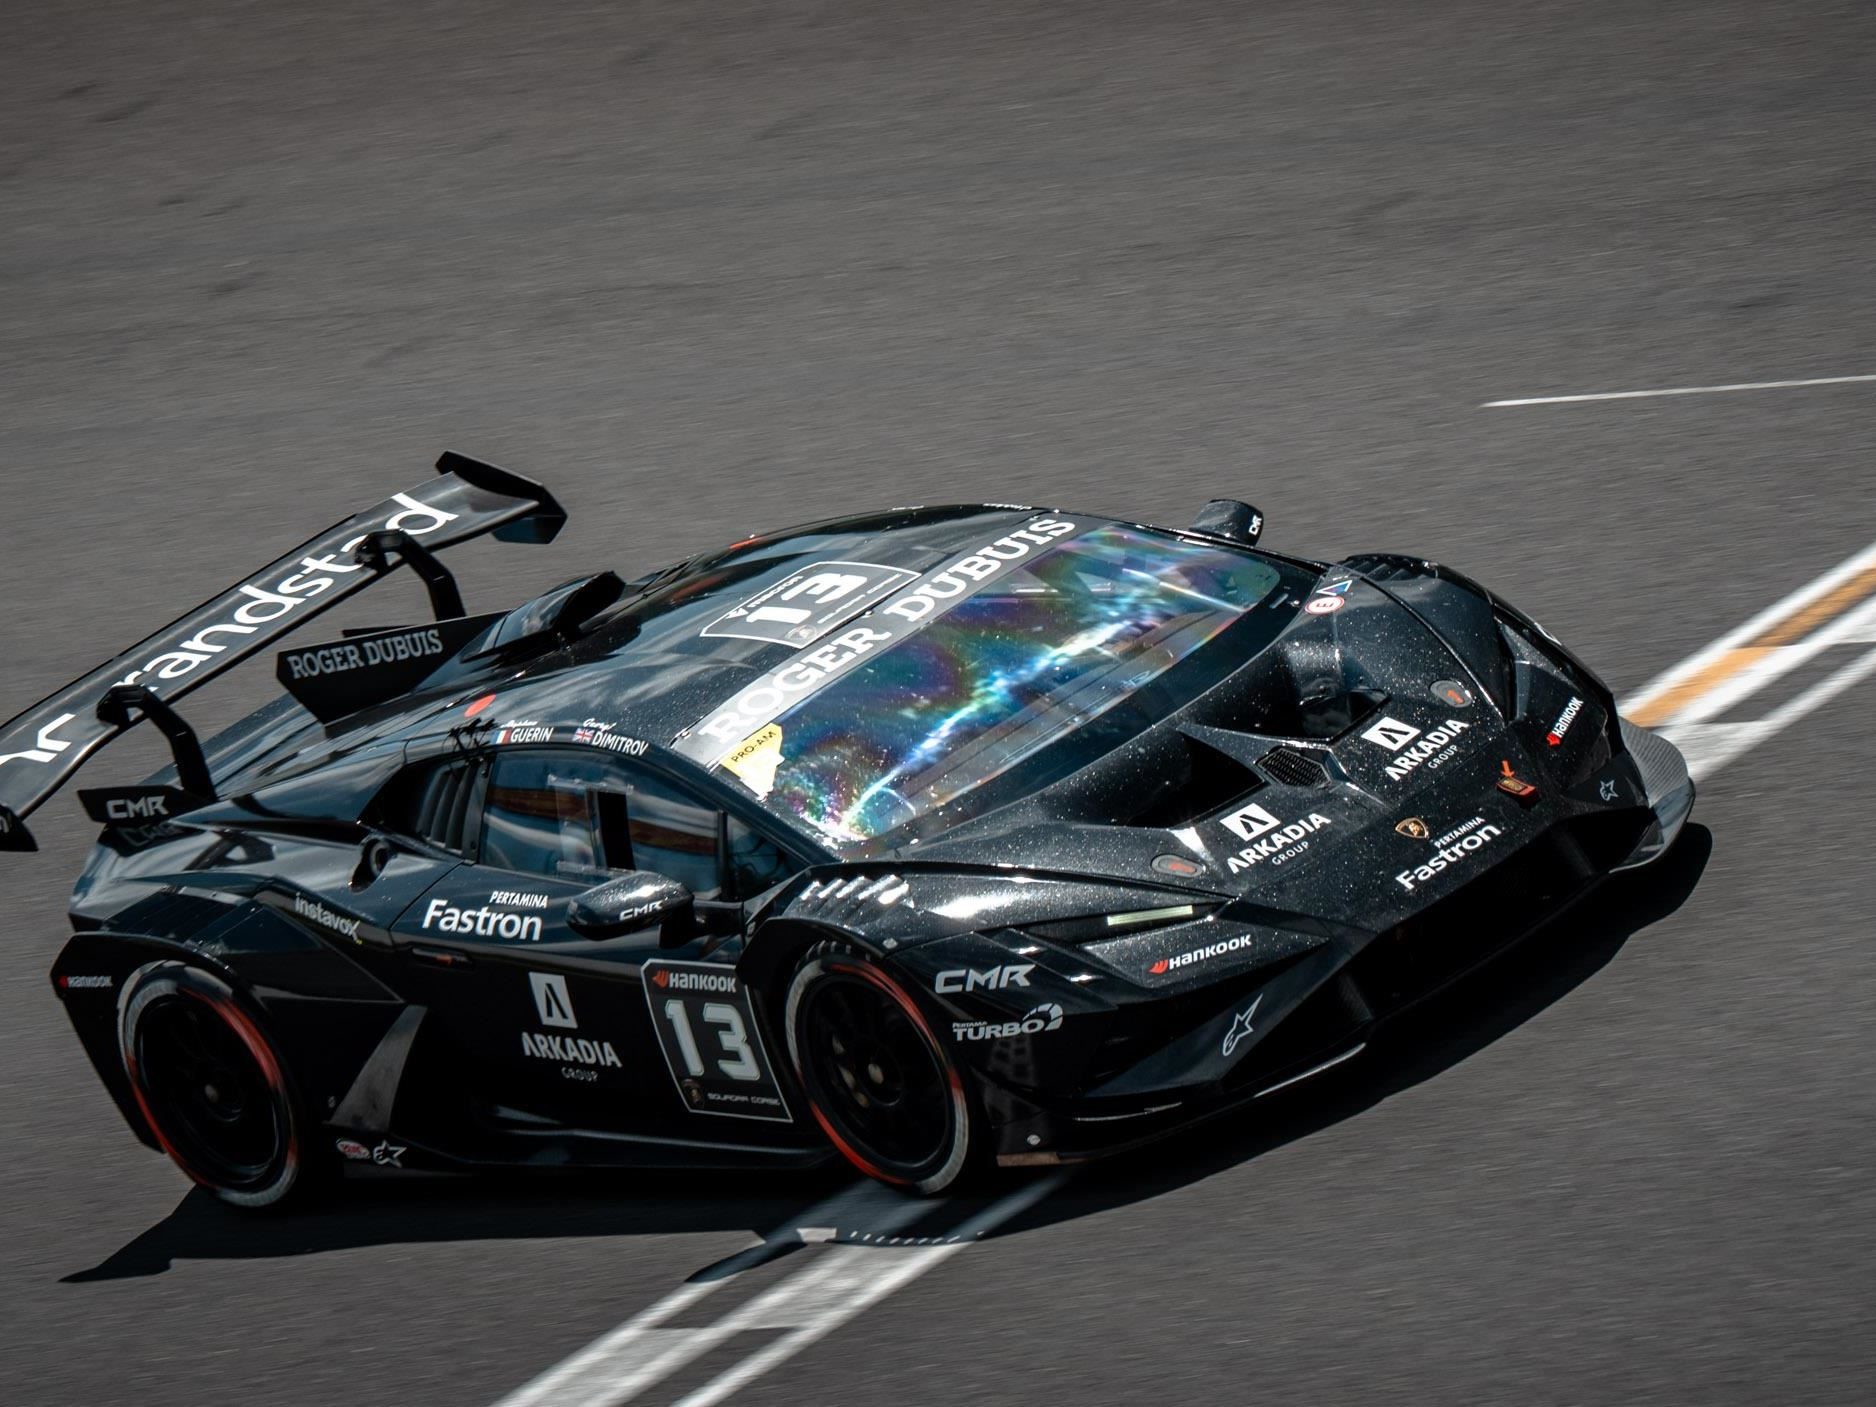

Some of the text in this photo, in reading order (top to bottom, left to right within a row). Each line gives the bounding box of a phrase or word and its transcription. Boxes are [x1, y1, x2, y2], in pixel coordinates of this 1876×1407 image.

[746, 573, 868, 624] 13
[697, 624, 893, 750] ROGER
[884, 515, 1077, 623] DUBUIS
[287, 628, 443, 679] ROGER DUBUIS
[510, 727, 554, 743] GUERIN
[602, 732, 649, 756] DIMITROV
[731, 731, 777, 763] PRO-AM
[1384, 719, 1471, 782] ARKADIA
[1427, 744, 1459, 769] GROUP
[106, 795, 170, 819] CMR
[1226, 812, 1332, 874] ARKADIA
[1434, 816, 1486, 848] PERTAMINA
[1271, 840, 1310, 866] GROUP
[1395, 823, 1503, 891] Fastron
[488, 890, 549, 909] PERTAMINA
[422, 898, 542, 942] Fastron
[935, 963, 1036, 994] CMR
[665, 999, 761, 1081] 13
[952, 1018, 1046, 1042] TURBO
[520, 1030, 624, 1069] ARKADIA
